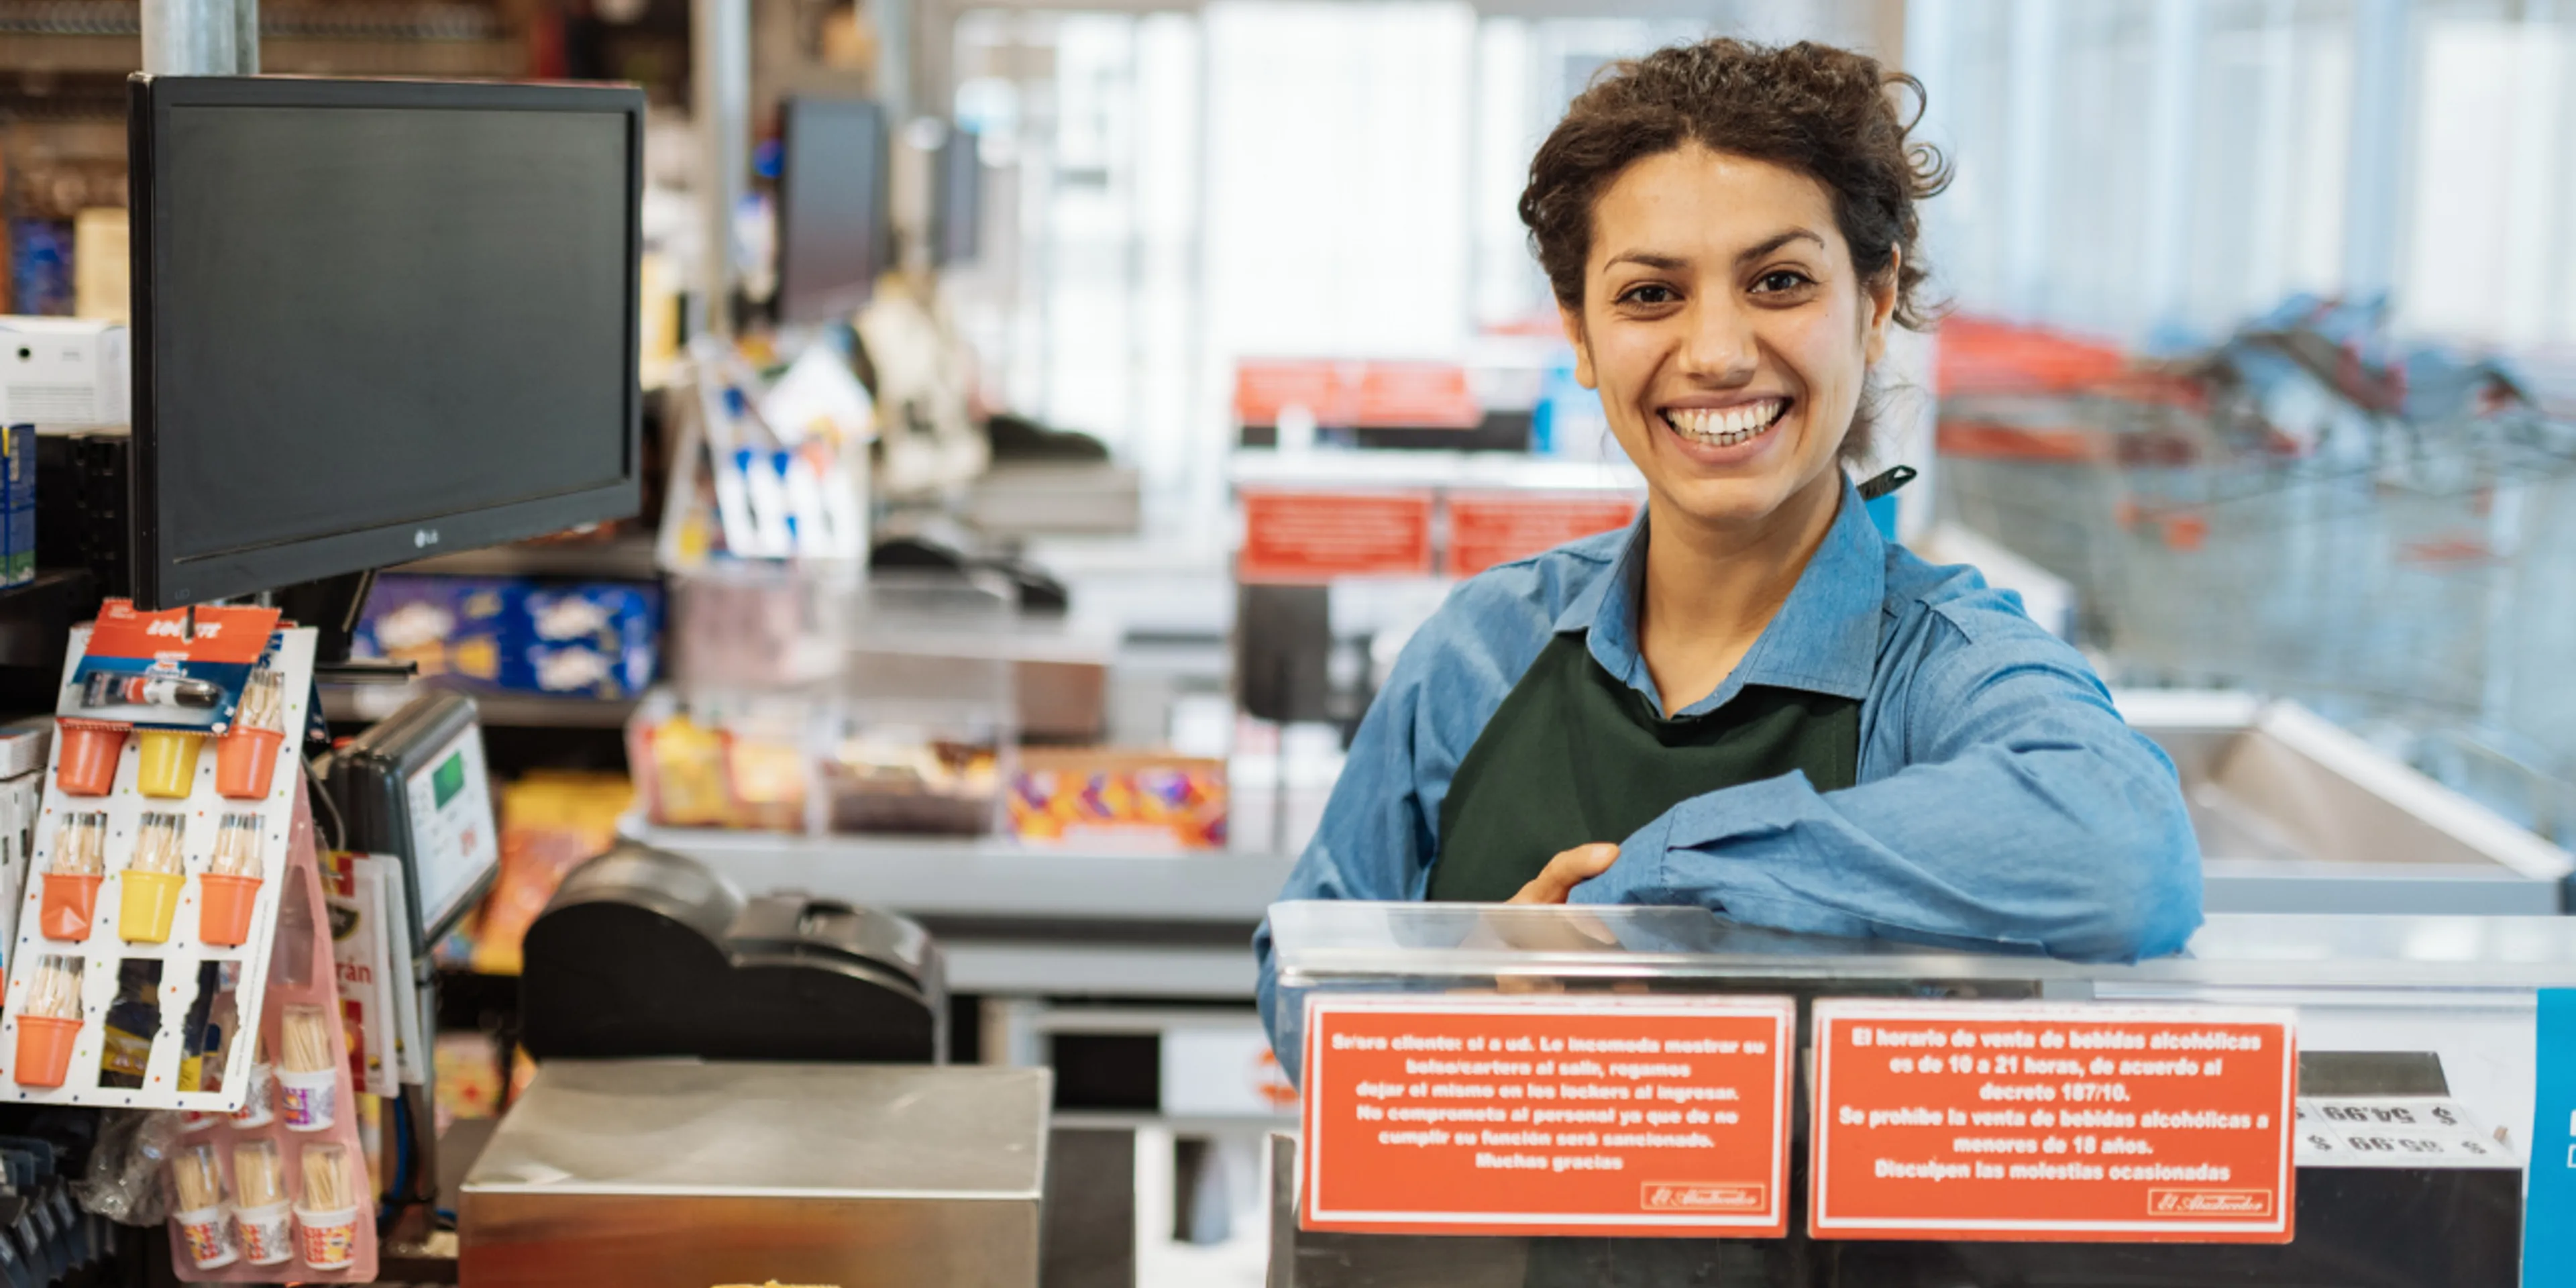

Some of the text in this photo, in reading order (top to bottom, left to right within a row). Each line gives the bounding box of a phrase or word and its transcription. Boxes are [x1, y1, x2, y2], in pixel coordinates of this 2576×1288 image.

[1466, 1036, 1485, 1051] si
[1488, 1038, 1503, 1051] a
[1505, 1036, 1535, 1051] ud.
[1539, 1037, 1565, 1053] Le
[1664, 1039, 1740, 1054] mostrar
[1742, 1041, 1767, 1055] su
[1851, 1026, 2262, 1051] El horario de venta de bebidas alcohólicas
[1535, 1060, 1555, 1075] al
[1558, 1060, 1605, 1077] salir,
[1608, 1063, 1692, 1079] rogamos
[1888, 1055, 2223, 1077] es de 10 a 21 horas, de acuerdo al
[1355, 1081, 1739, 1103] dejar el mismo en los lockers al ingresar.
[1978, 1082, 2131, 1102] decreto 187/10.
[1356, 1105, 1739, 1126] No comprometa al personal ya que de no
[1839, 1106, 1866, 1125] Se
[1947, 1108, 1968, 1126] la
[1970, 1110, 2027, 1126] venta
[2029, 1109, 2055, 1127] de
[2059, 1110, 2136, 1128] bebidas
[2140, 1110, 2252, 1128] alcohólicas
[2256, 1114, 2269, 1128] a
[2322, 1106, 2417, 1124] 54.99
[2431, 1106, 2458, 1126] $
[1378, 1130, 1451, 1147] cumplir
[1453, 1132, 1478, 1145] su
[1602, 1132, 1715, 1147] sancionado.
[1953, 1134, 2153, 1154] menores de 18 años.
[1475, 1153, 1624, 1172] Muchas gracias
[1874, 1159, 2231, 1181] Disculpen las molestias ocasionadas
